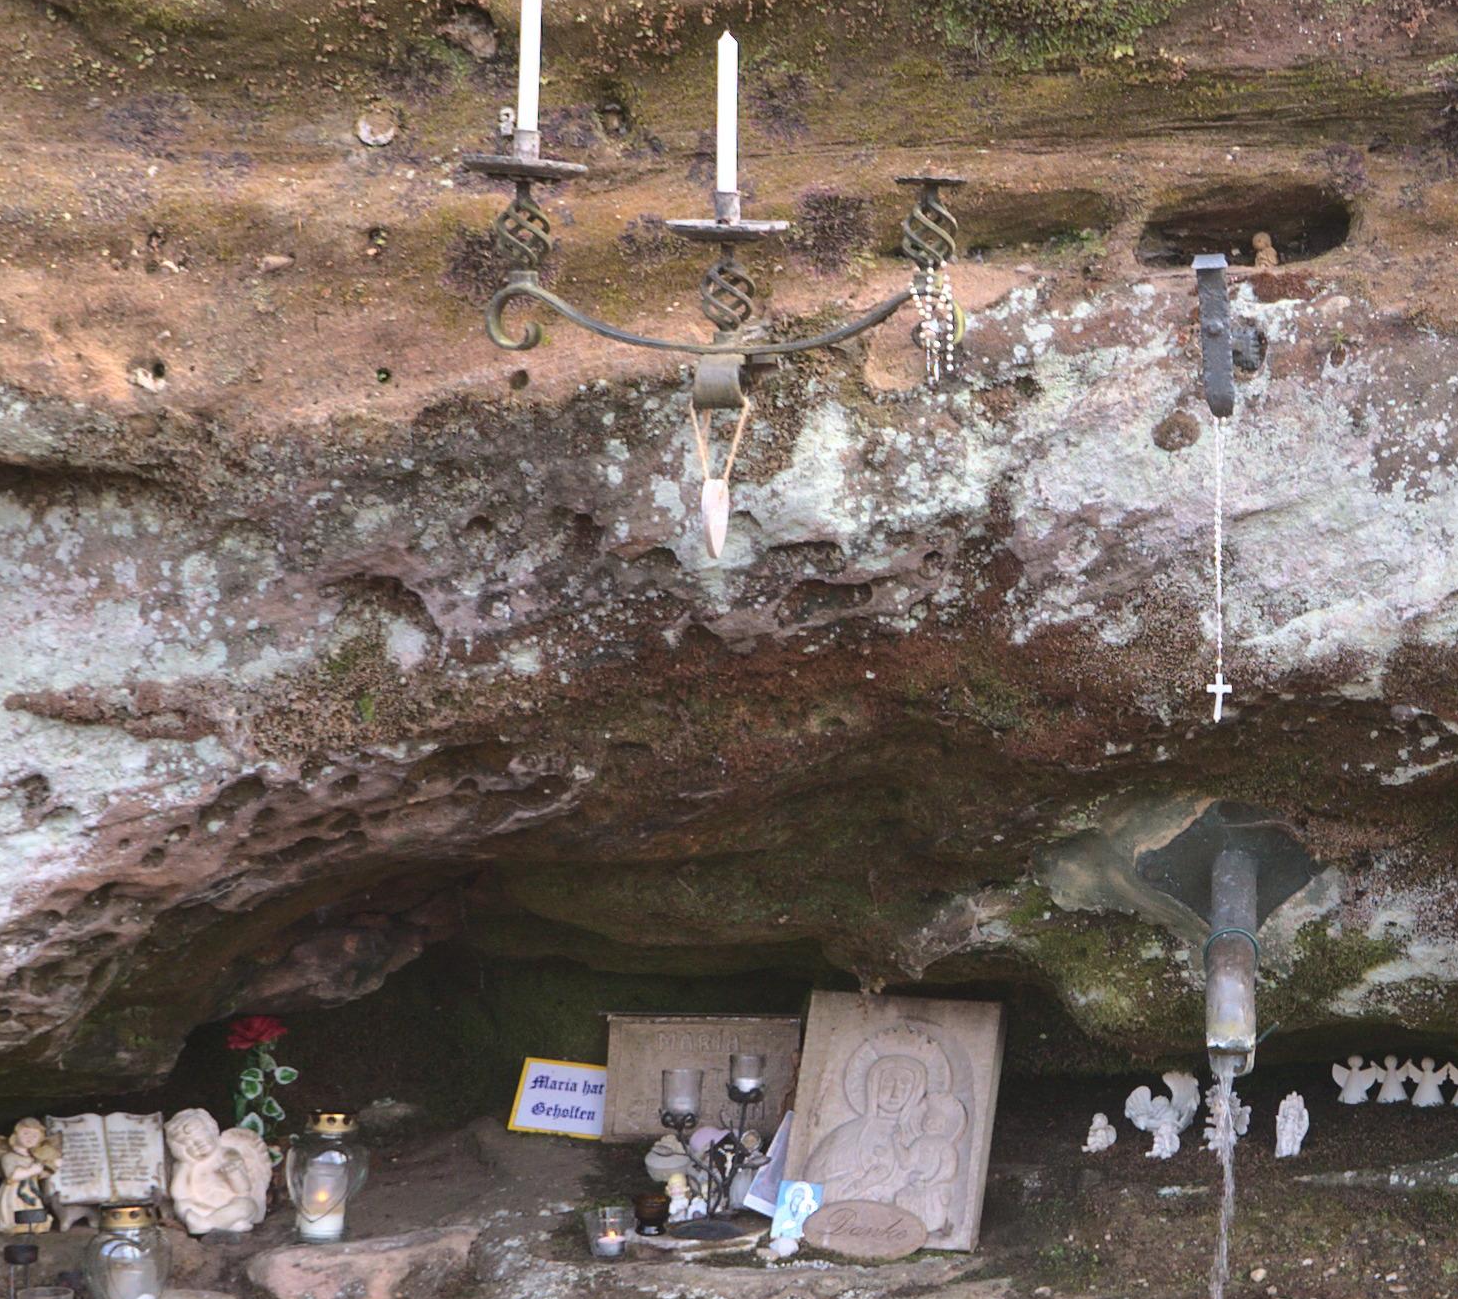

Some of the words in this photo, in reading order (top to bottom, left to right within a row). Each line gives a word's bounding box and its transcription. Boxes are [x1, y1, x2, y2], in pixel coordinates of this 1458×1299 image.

[657, 1030, 741, 1052] MARIA
[530, 1075, 578, 1092] Maria
[582, 1079, 605, 1096] hat
[531, 1102, 596, 1120] Geholfen
[817, 1207, 908, 1240] Danke
